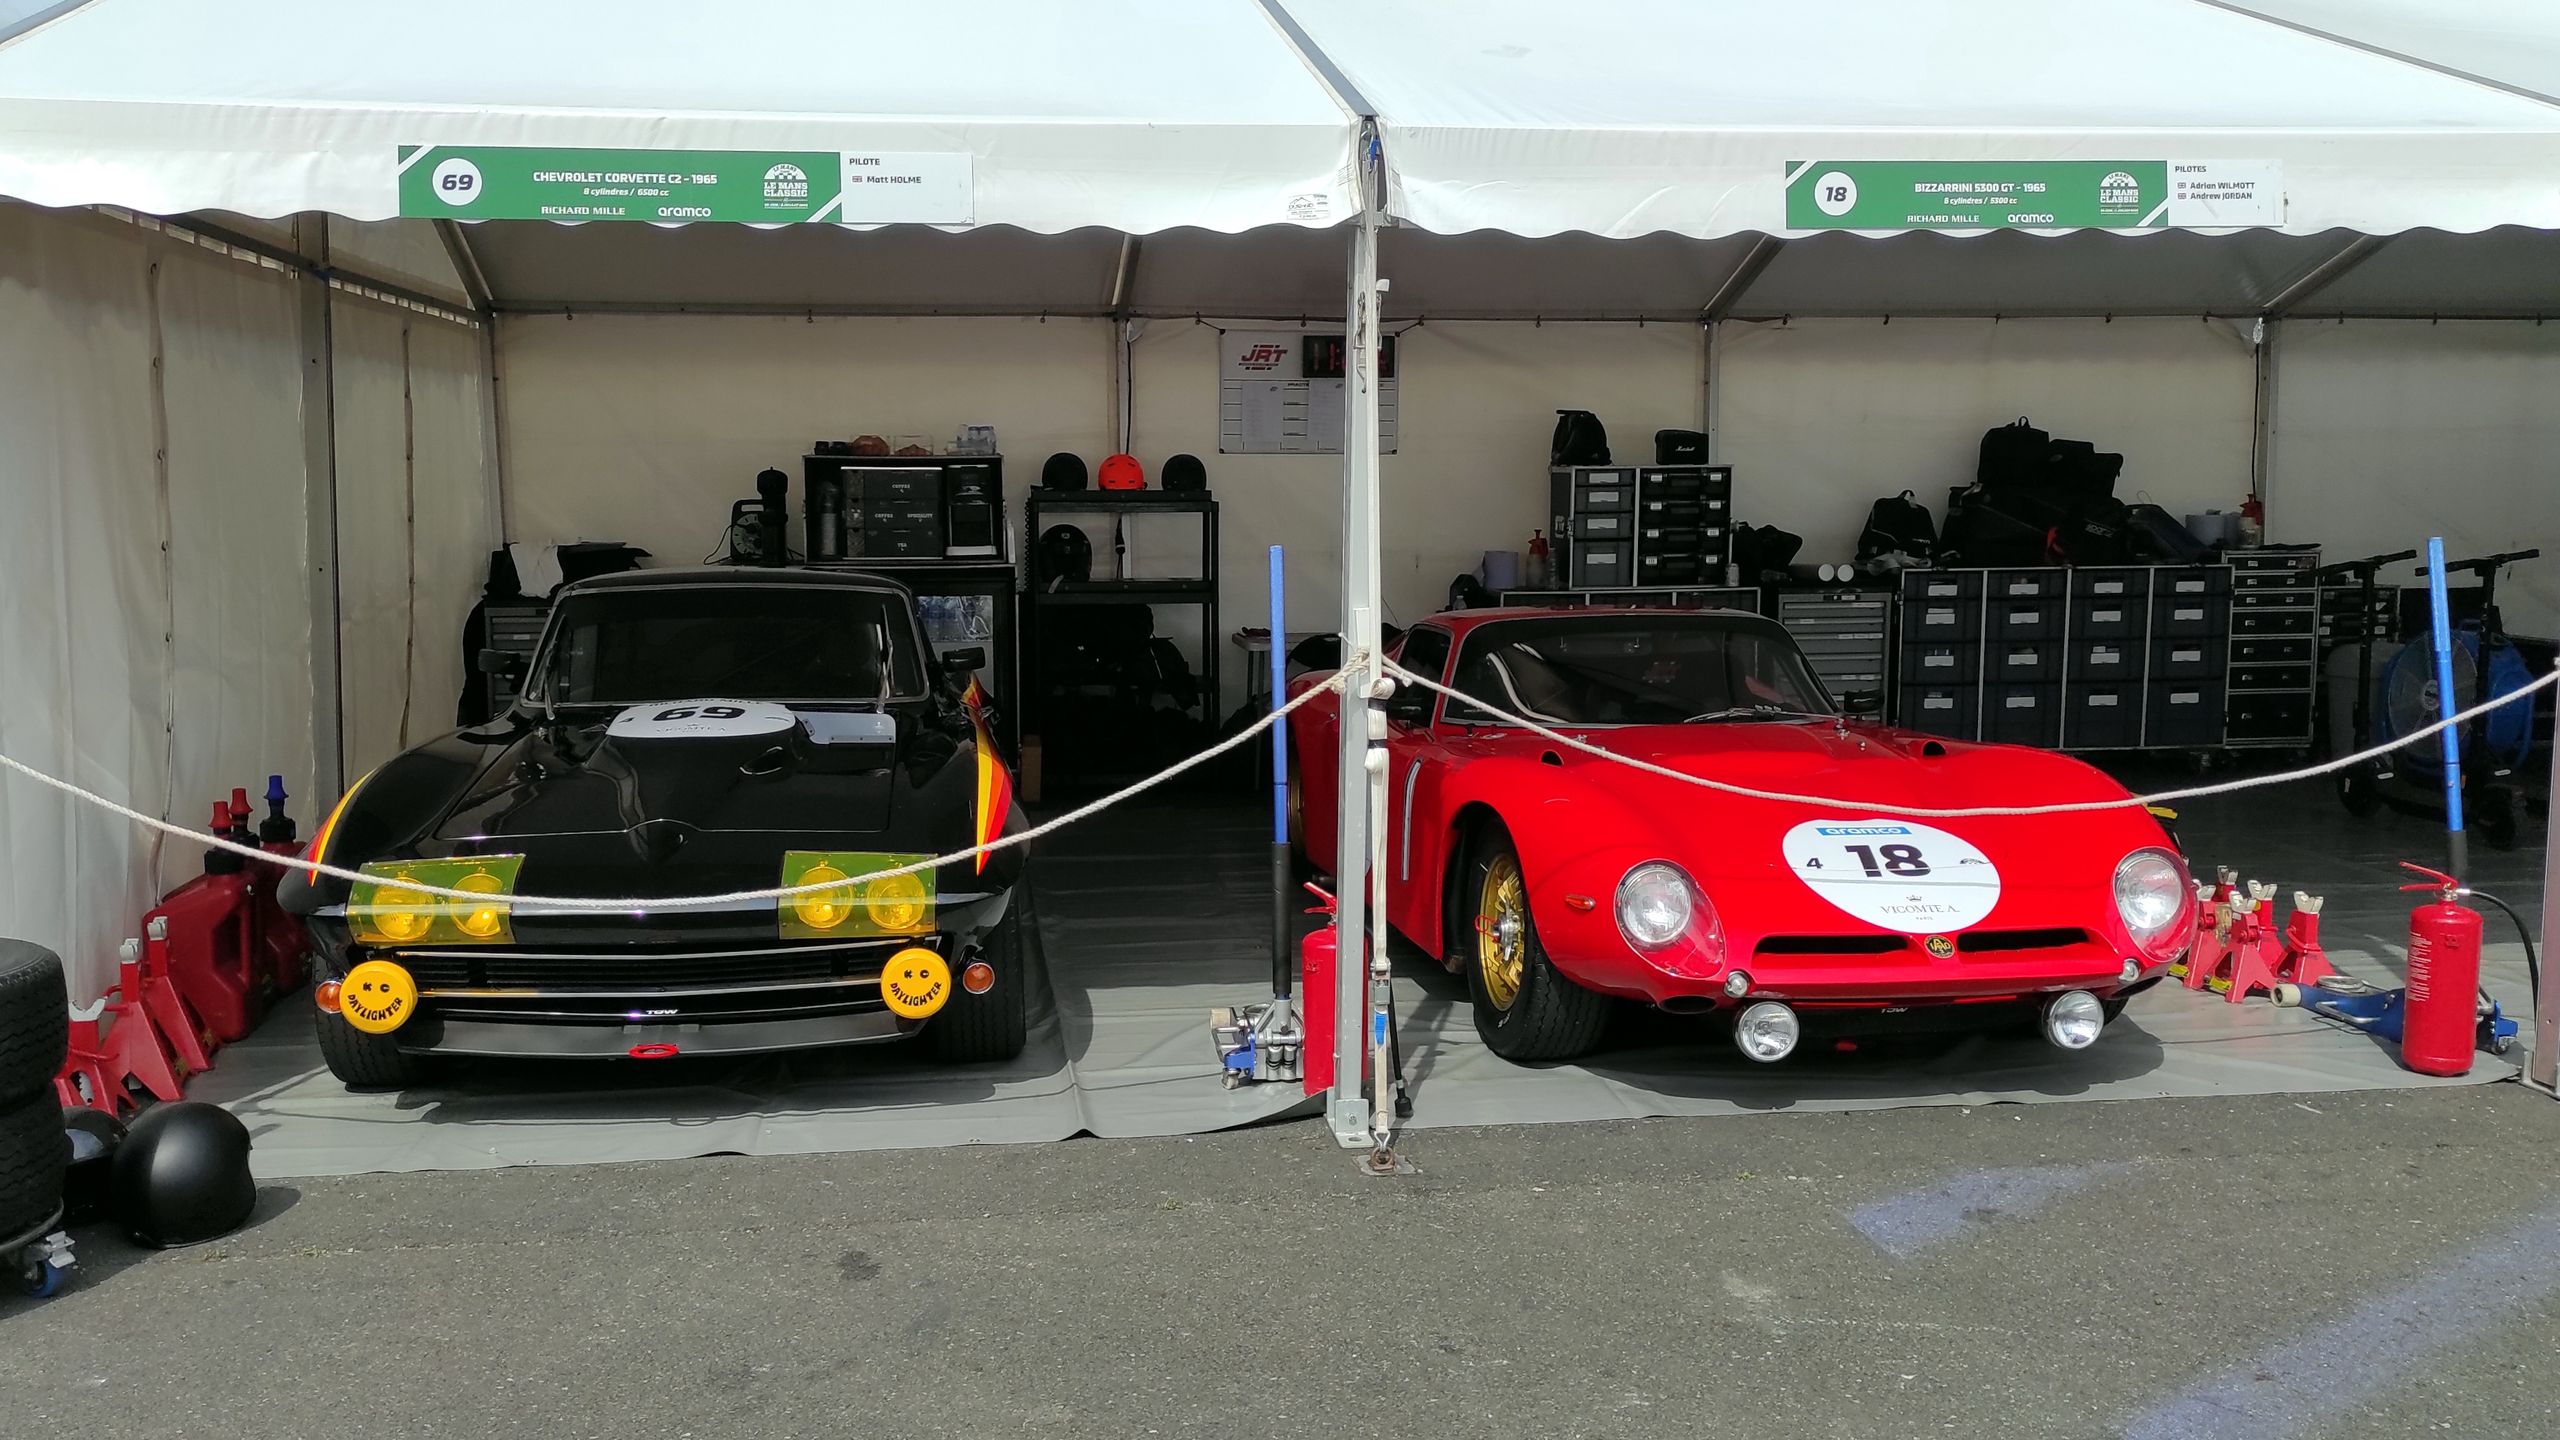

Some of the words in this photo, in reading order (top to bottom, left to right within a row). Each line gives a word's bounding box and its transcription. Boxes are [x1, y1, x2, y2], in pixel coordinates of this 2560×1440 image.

[442, 174, 474, 191] 69
[533, 172, 603, 183] CHEVROLET
[605, 173, 666, 183] CORVETTE
[668, 174, 682, 184] C2
[691, 174, 718, 184] 1965
[590, 187, 628, 197] cylindres
[637, 188, 659, 196] 6500
[1915, 183, 1973, 193] BIZZARRINI
[1974, 183, 2000, 193] 5300
[2001, 183, 2015, 193] GT
[2023, 183, 2046, 193] 1965
[1825, 186, 1848, 202] 18
[1950, 197, 1983, 206] cylindres
[541, 206, 590, 215] RICHARD
[593, 207, 626, 215] MILLE
[658, 207, 711, 217] aramco
[1907, 215, 1949, 223] RICHARD
[1951, 215, 1980, 223] MILLE
[2007, 214, 2055, 223] aramco
[652, 706, 746, 721] 69
[1826, 827, 1901, 835] aramco
[1806, 857, 1823, 869] 4
[1844, 843, 1931, 878] 18
[1880, 904, 1945, 914] VICOMTE
[890, 982, 942, 1006] DAYLIGHTER
[348, 994, 403, 1021] DAYLIGHTER
